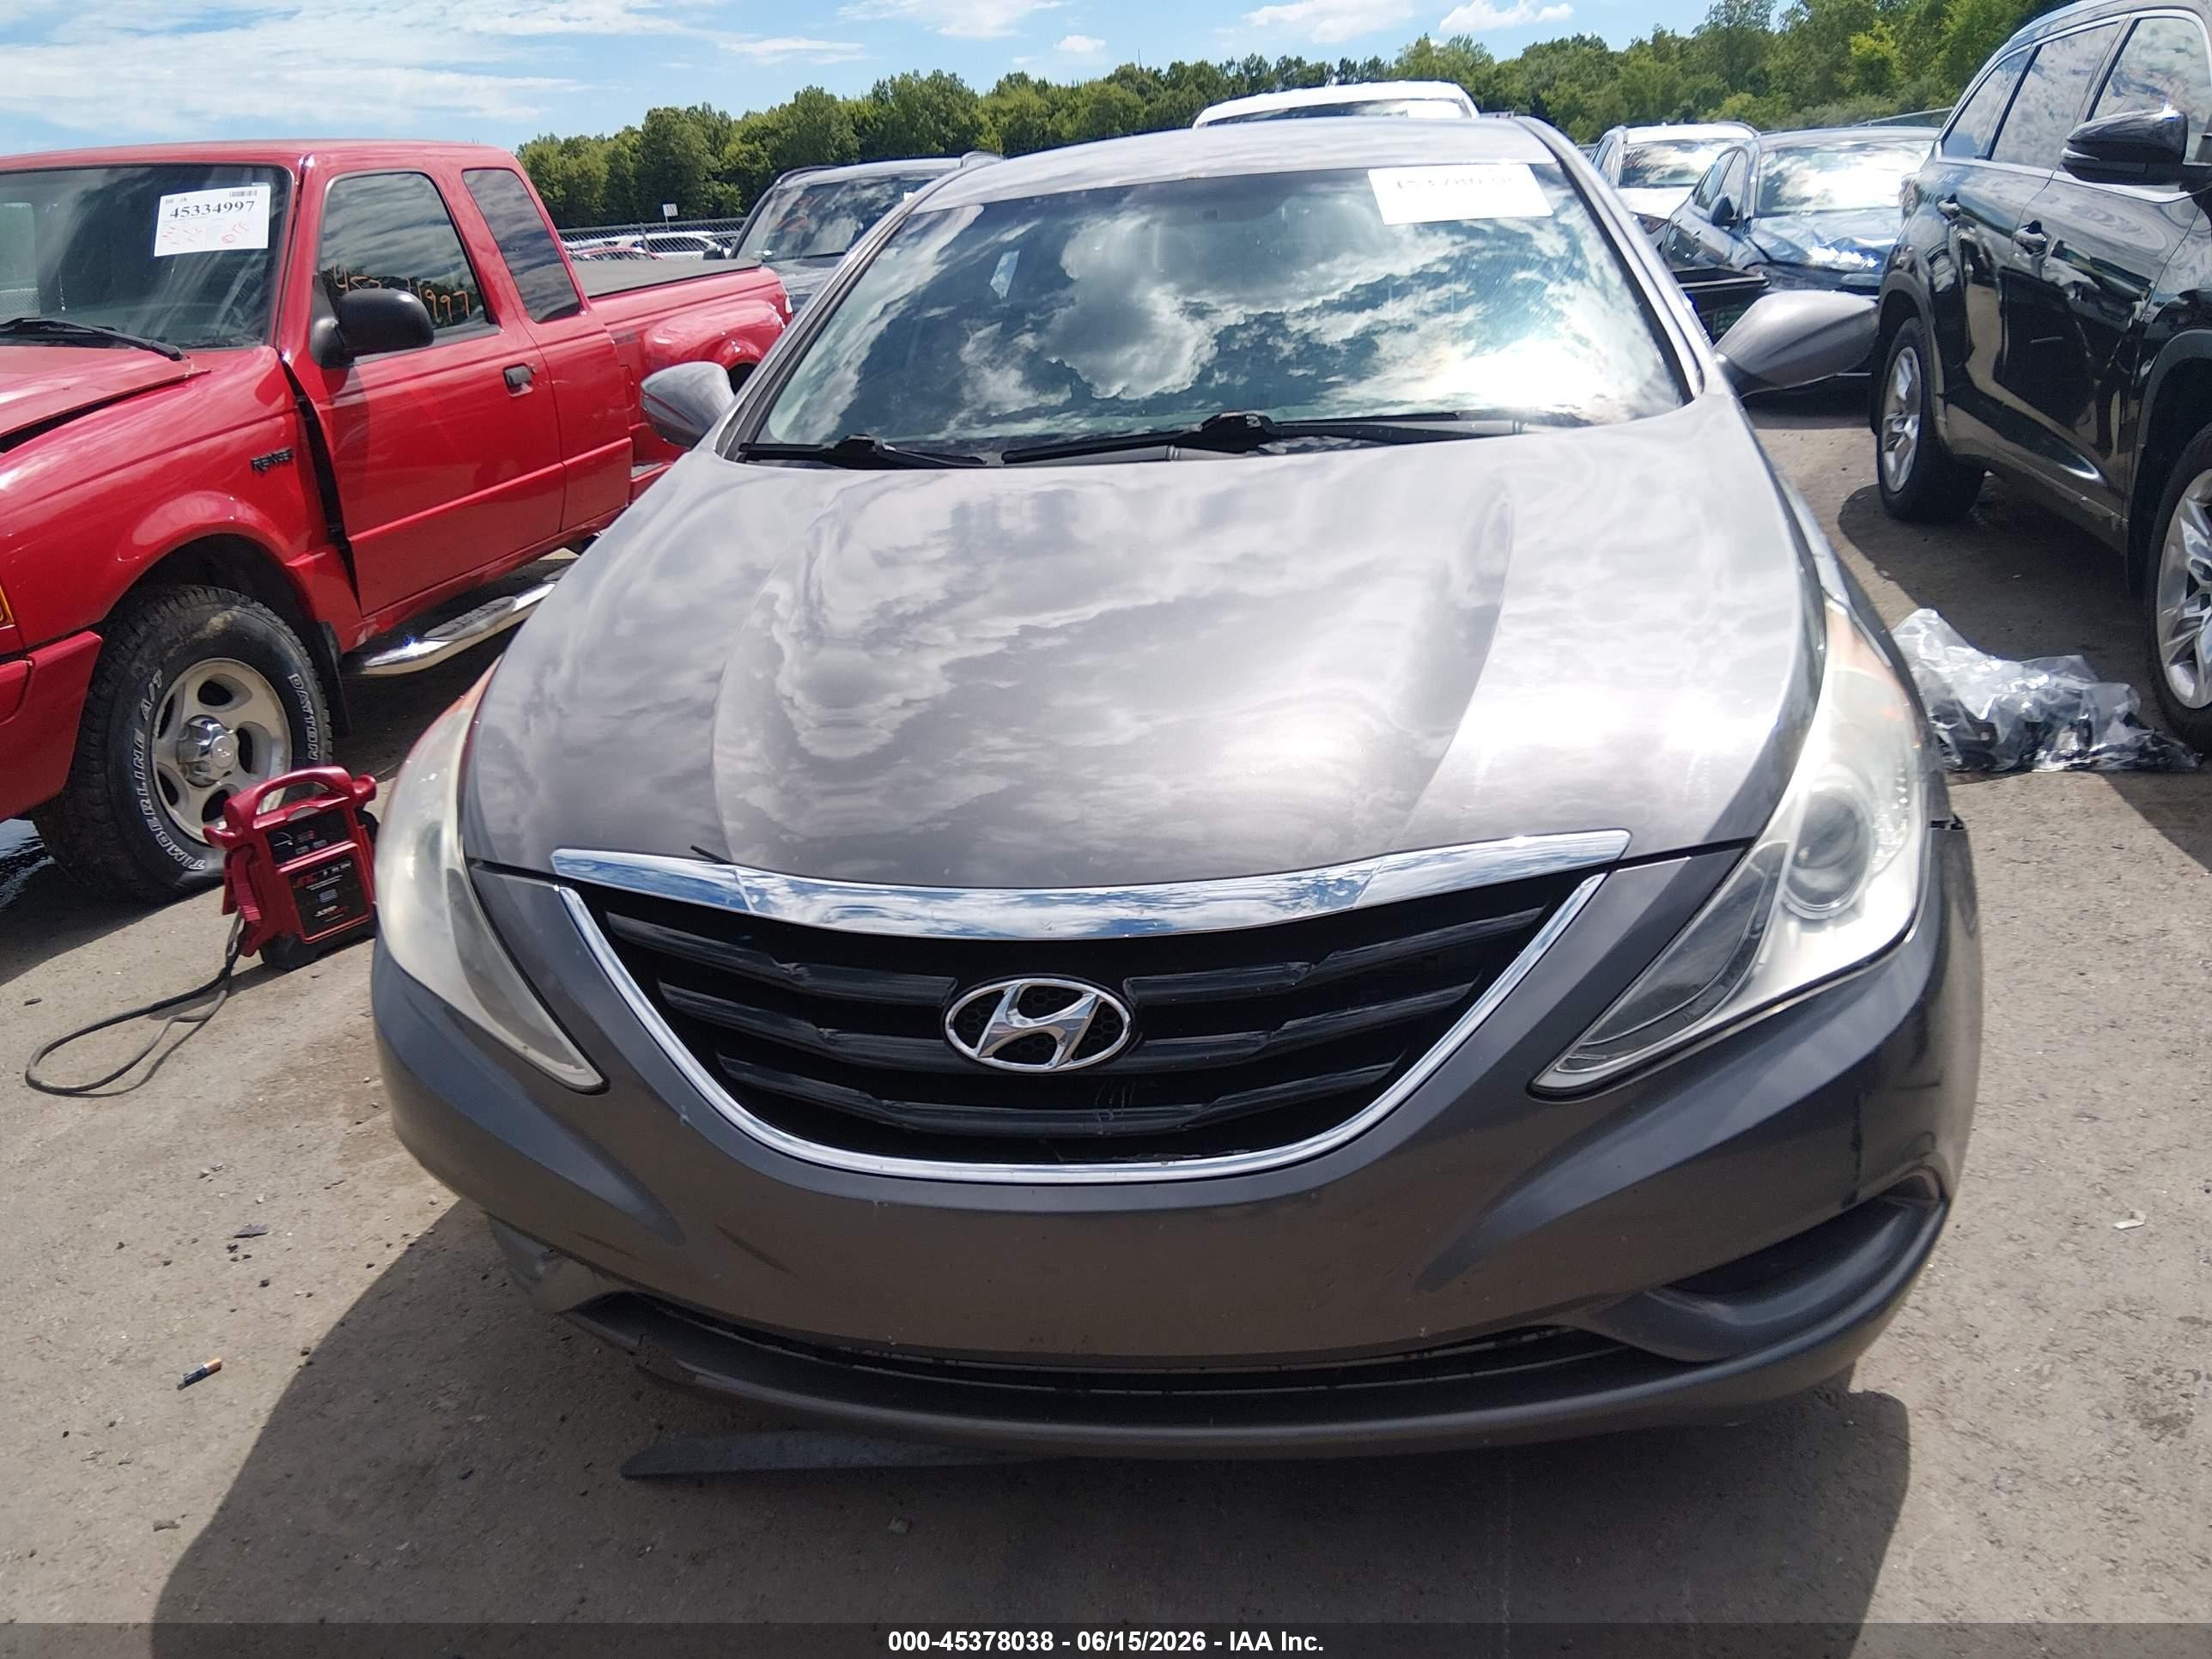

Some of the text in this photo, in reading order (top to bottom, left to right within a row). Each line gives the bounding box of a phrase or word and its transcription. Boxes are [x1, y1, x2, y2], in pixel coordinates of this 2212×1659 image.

[170, 200, 255, 218] 45334997
[288, 673, 319, 761] DAYTON
[132, 669, 206, 871] TIMBERLINE A/T
